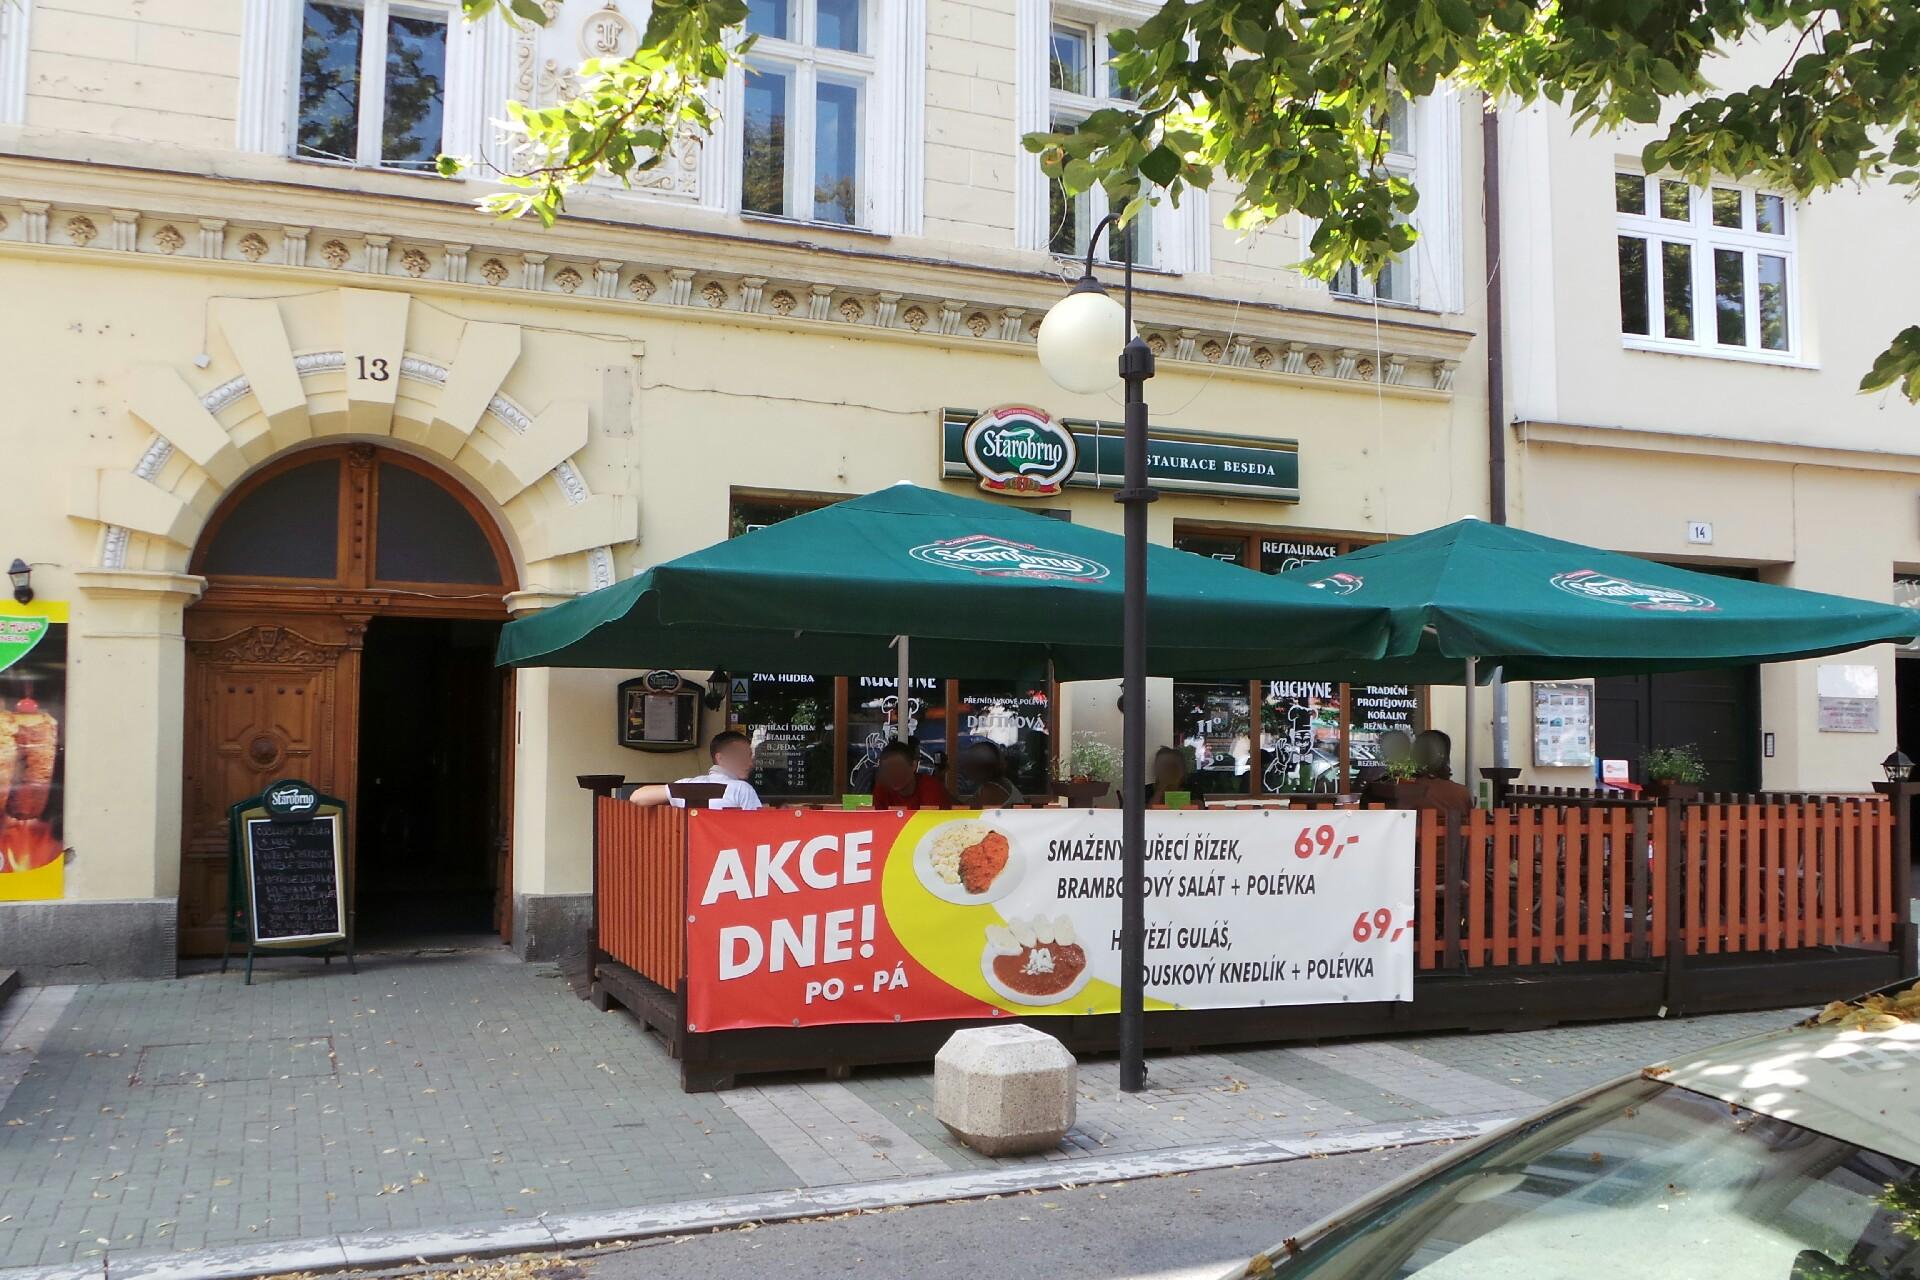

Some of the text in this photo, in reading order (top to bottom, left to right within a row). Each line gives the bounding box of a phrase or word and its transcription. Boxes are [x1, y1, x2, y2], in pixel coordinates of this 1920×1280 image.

[354, 355, 389, 381] 13
[982, 428, 1063, 473] Starobrno
[1223, 460, 1276, 476] BESEDA
[1695, 526, 1705, 539] 14
[934, 545, 1083, 572] Starobrno
[1262, 541, 1336, 557] RESTAURACE
[778, 674, 815, 683] HUDBA
[1366, 684, 1409, 696] TRADIČNÍ
[1367, 710, 1408, 720] KOŘALKY
[272, 788, 314, 812] Starobrno
[1144, 832, 1190, 861] UŘECÍ
[1193, 832, 1243, 863] ŘÍZEK,
[1294, 824, 1360, 860] 69,-
[700, 829, 873, 906] AKCE
[1057, 869, 1175, 899] BRAMBOOVÝ
[1178, 868, 1226, 897] SALÁT
[1247, 865, 1316, 896] POLÉVKA
[719, 904, 876, 981] DNE!
[1177, 919, 1233, 951] GULÁŠ,
[805, 977, 845, 1005] PO
[873, 960, 910, 993] PÁ
[1143, 956, 1216, 988] OUSKOVÝ
[1219, 954, 1286, 984] KNEDLÍK
[1307, 951, 1375, 980] POLÉVKA
